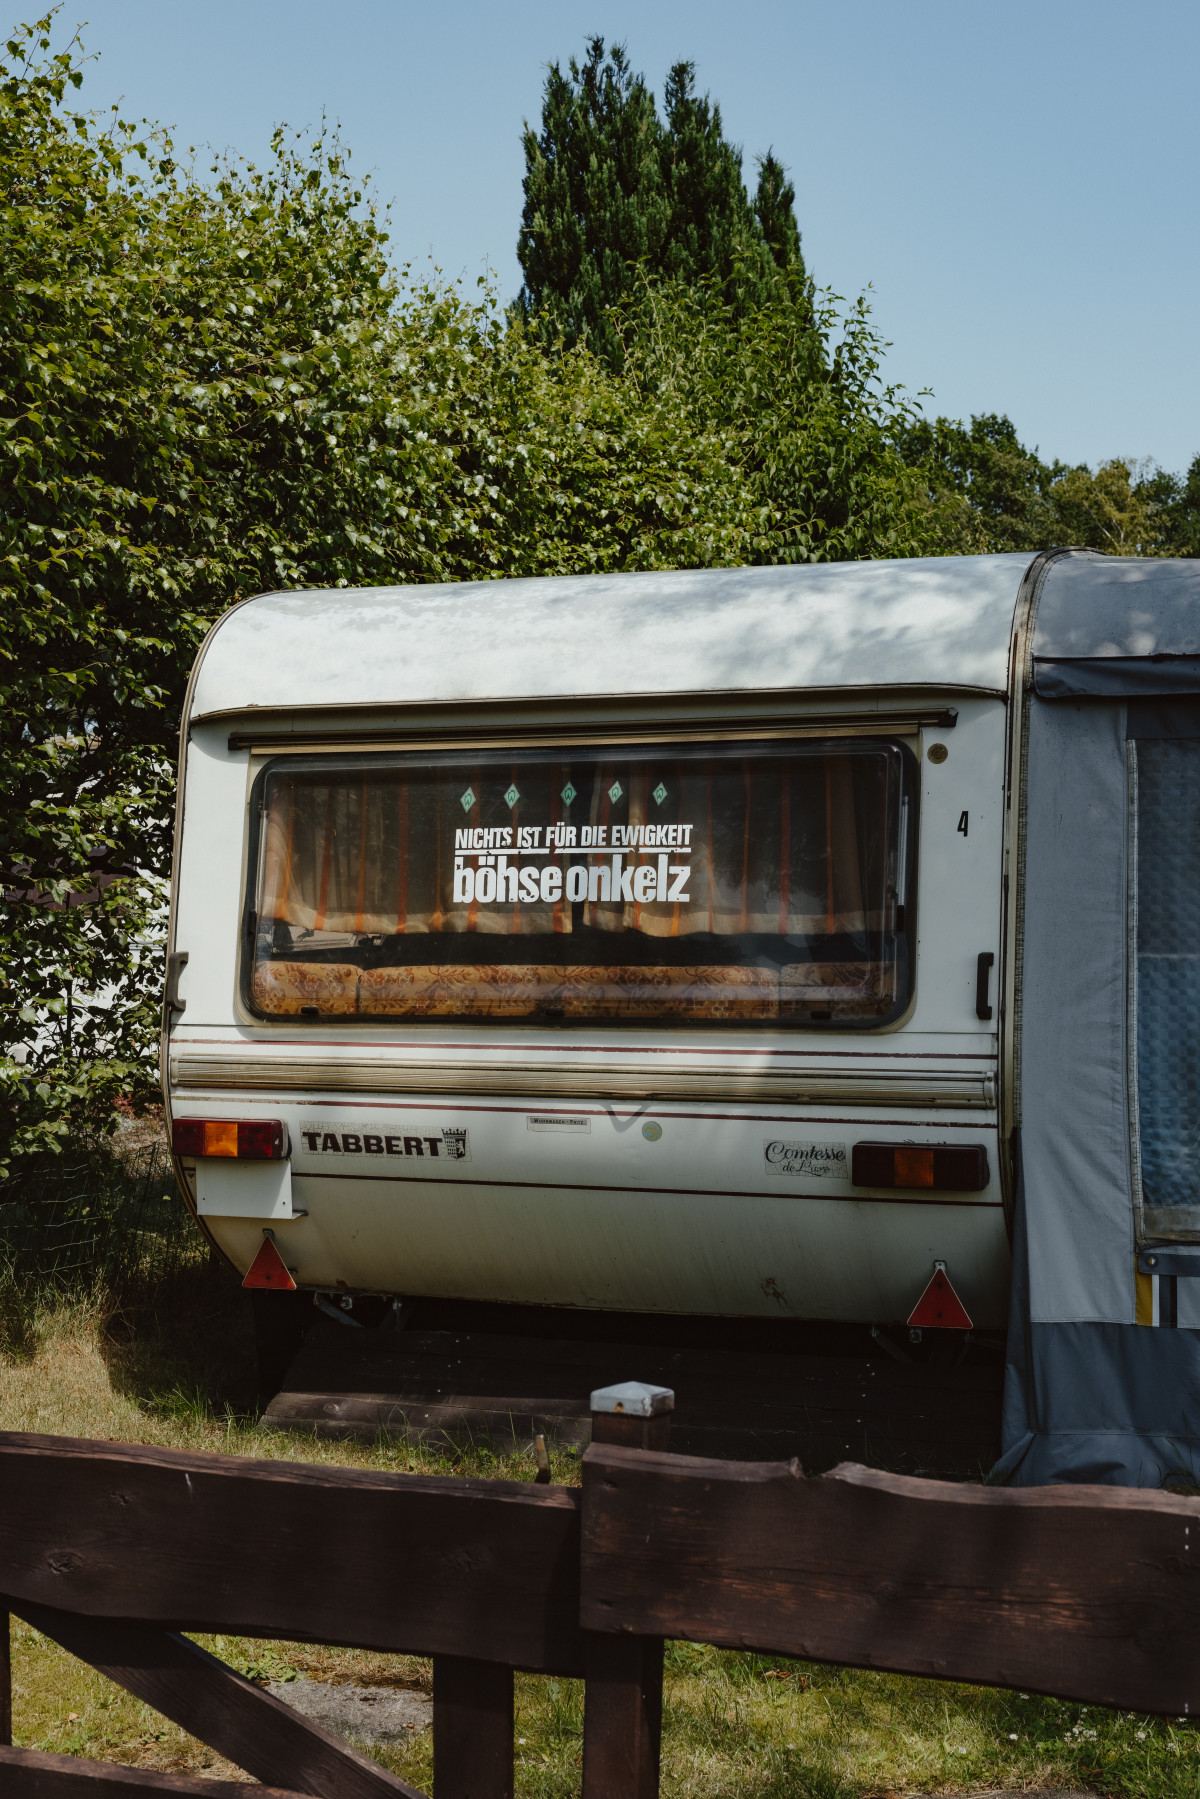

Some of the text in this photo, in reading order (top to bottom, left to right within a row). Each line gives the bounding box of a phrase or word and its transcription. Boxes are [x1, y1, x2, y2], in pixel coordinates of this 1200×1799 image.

[455, 822, 693, 849] NICHTS IST FÜR DIE EWIGKEIT
[957, 811, 969, 837] 4
[302, 1132, 443, 1157] TABBERT
[765, 1141, 846, 1163] Comtesse
